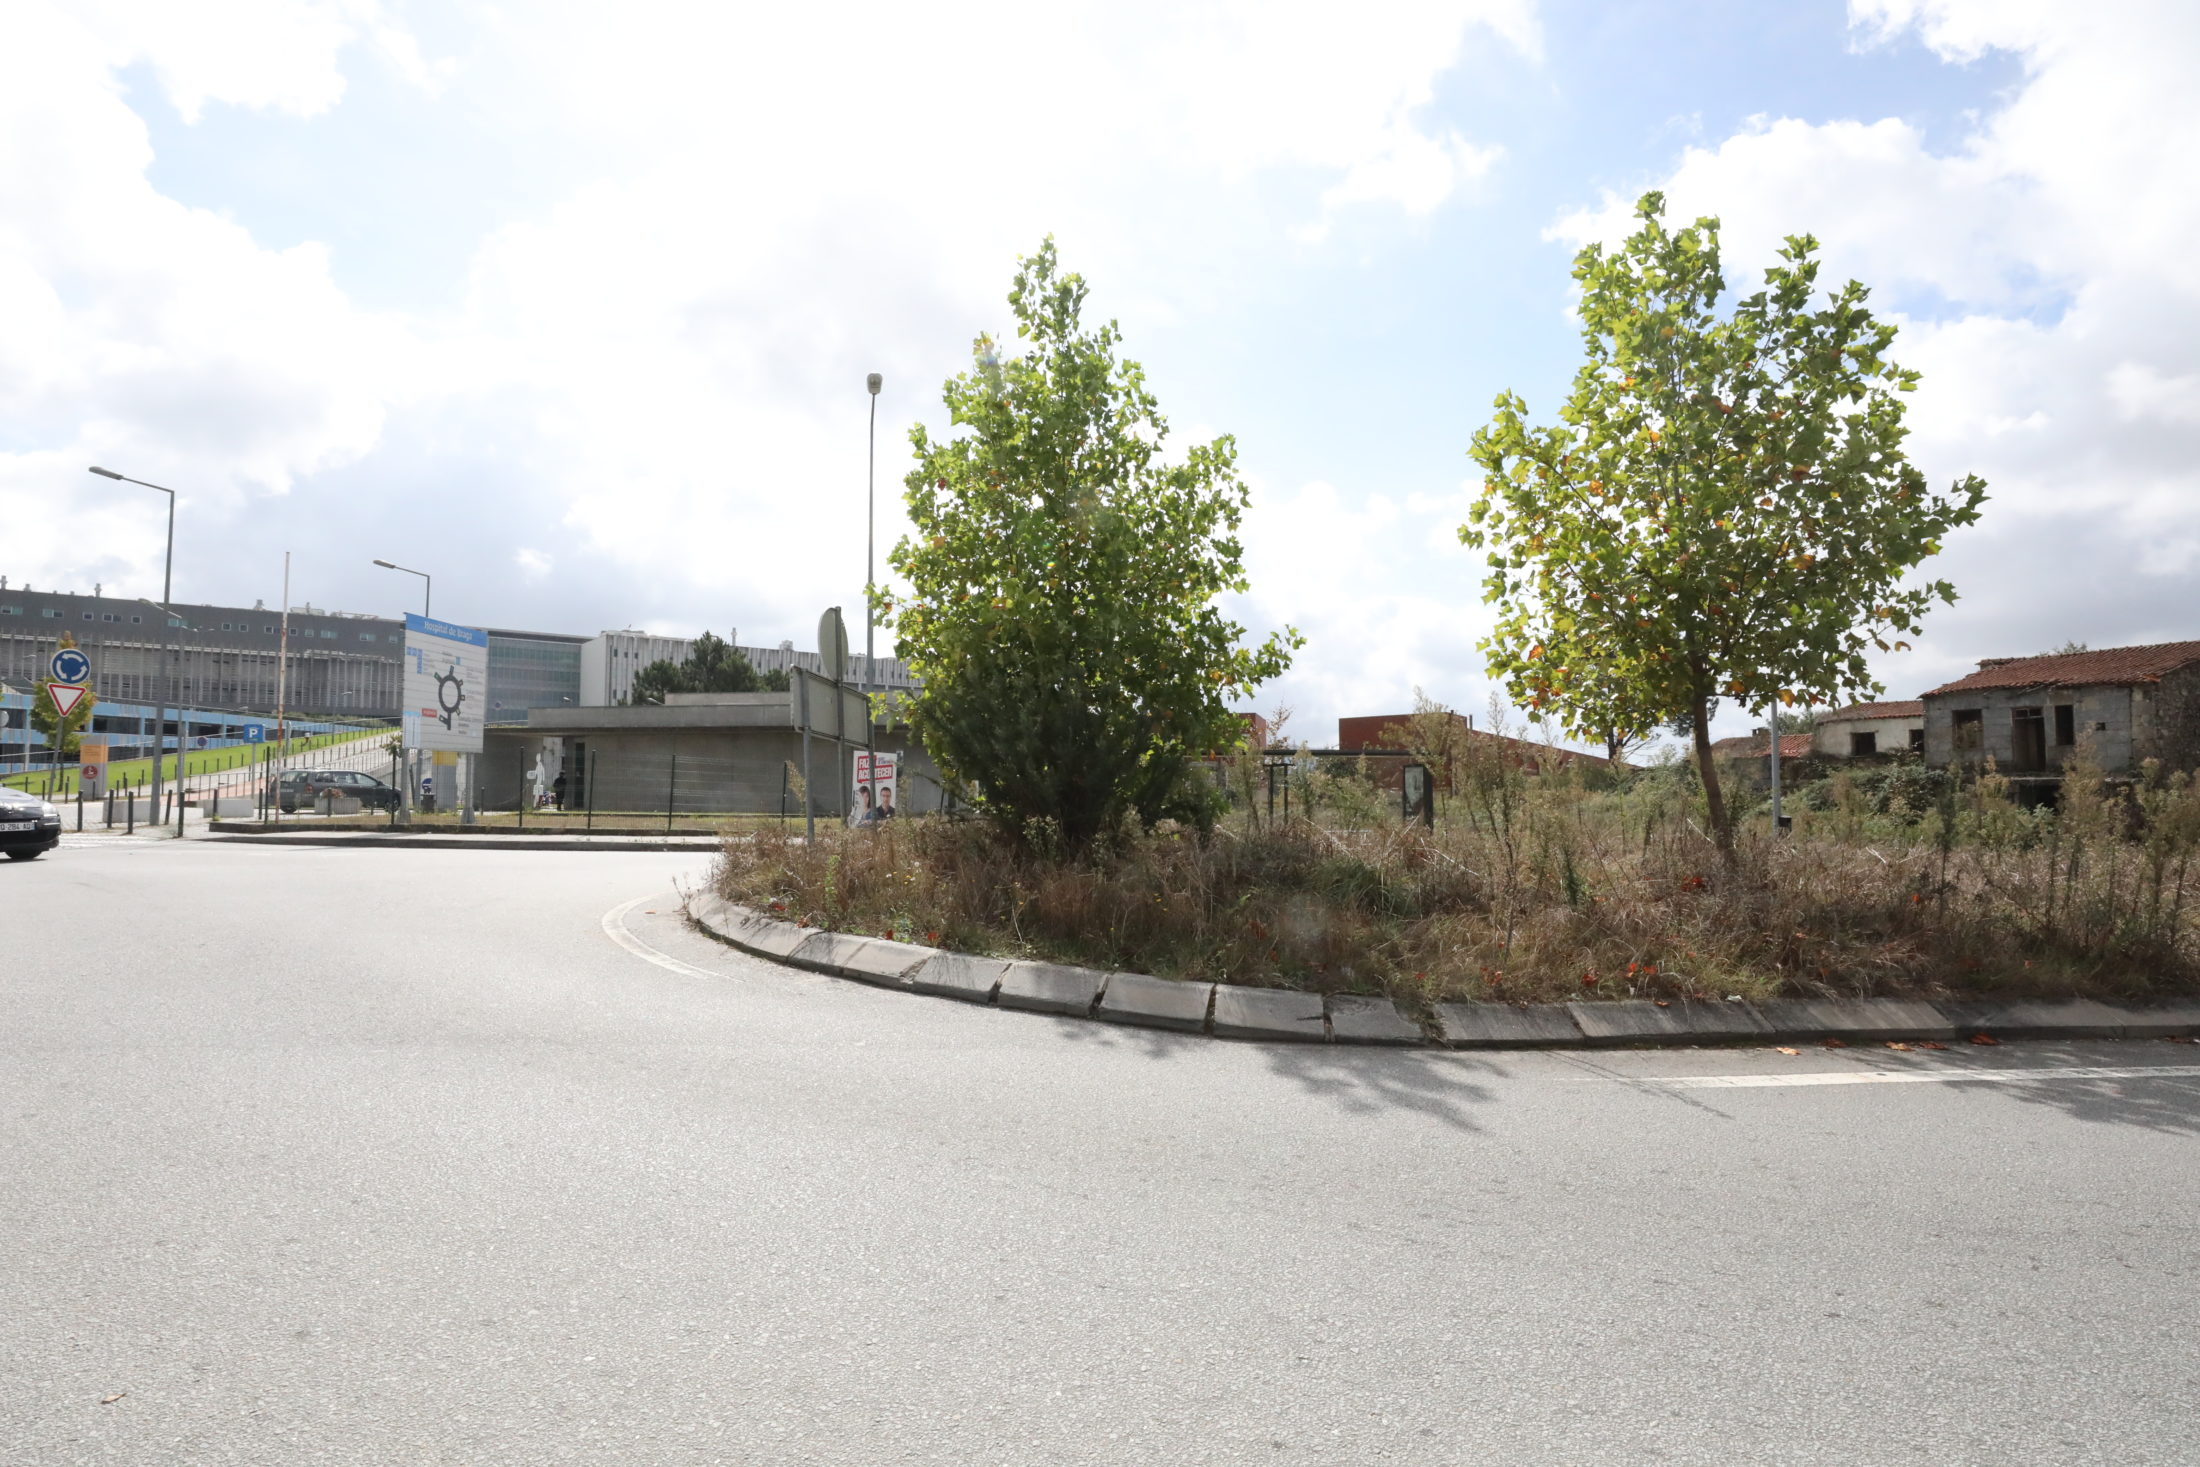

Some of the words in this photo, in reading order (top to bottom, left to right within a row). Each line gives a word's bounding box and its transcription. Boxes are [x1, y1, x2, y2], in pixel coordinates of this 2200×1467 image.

[424, 621, 448, 634] Hospital
[448, 626, 457, 636] de
[249, 728, 258, 738] P
[858, 766, 892, 779] ACOTECER
